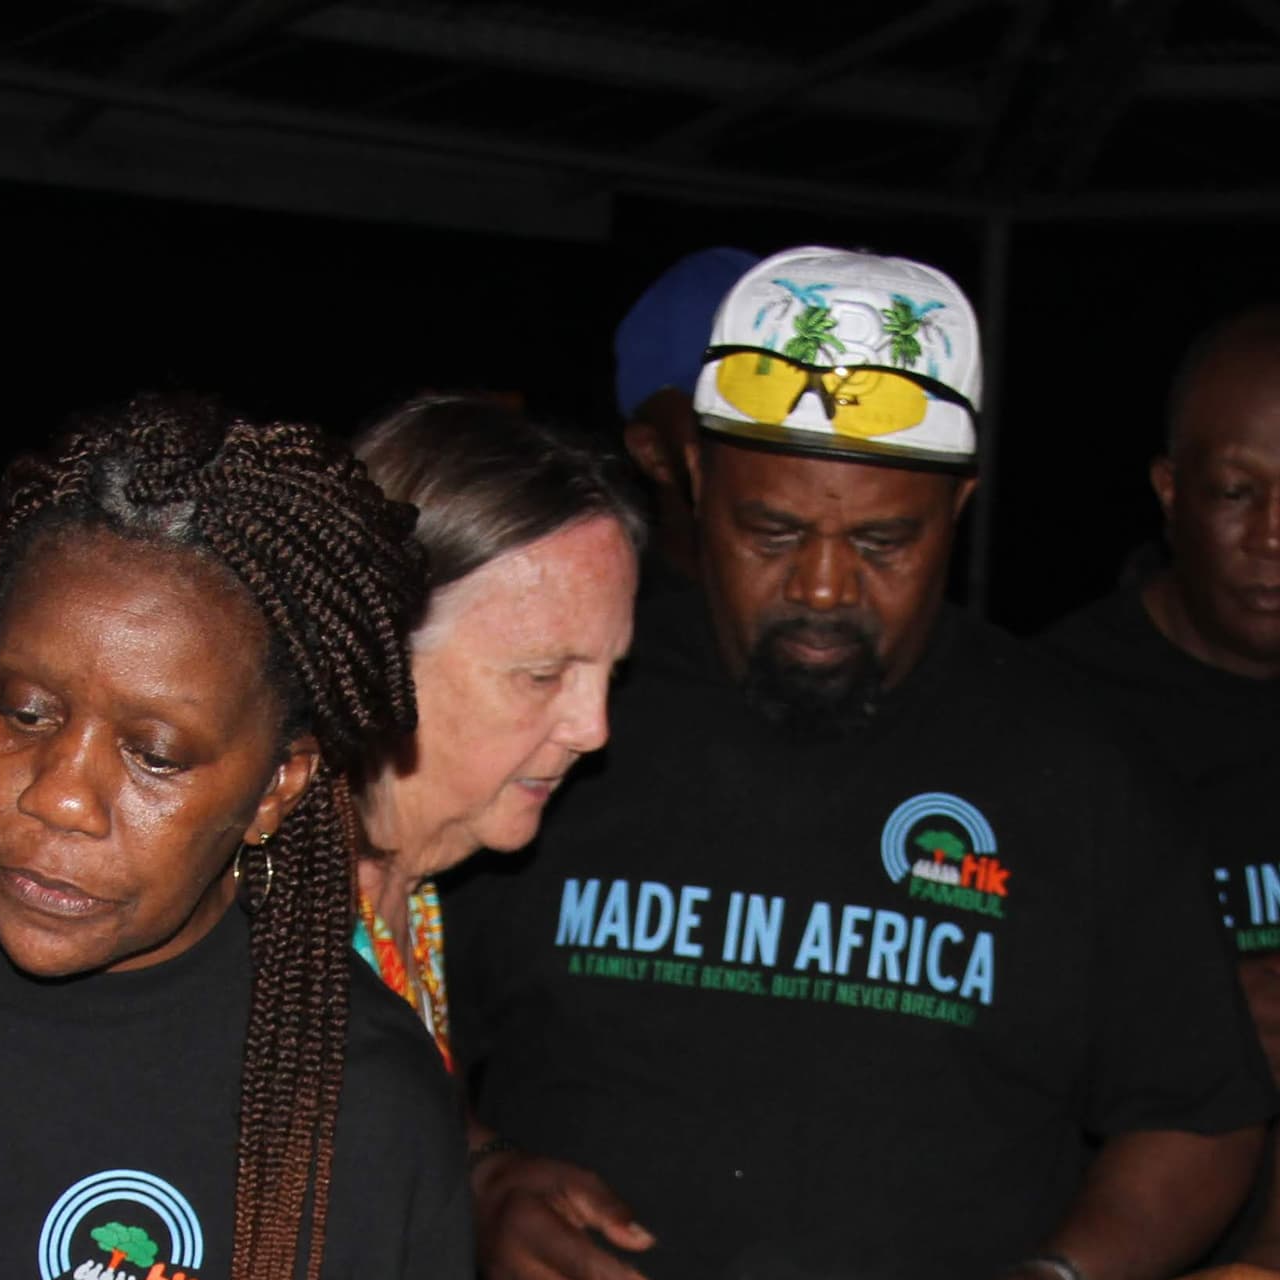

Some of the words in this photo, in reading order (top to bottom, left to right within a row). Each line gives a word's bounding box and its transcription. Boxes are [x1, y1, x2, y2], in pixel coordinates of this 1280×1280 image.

[961, 853, 1012, 898] tik
[555, 877, 711, 958] MADE
[722, 891, 785, 967] IN
[793, 901, 996, 1006] AFRICA
[567, 953, 583, 976] A
[584, 955, 648, 981] FAMILY
[652, 961, 698, 988] TREE
[771, 974, 810, 999] BUT
[813, 978, 833, 1001] IT
[835, 981, 899, 1011] NEVER
